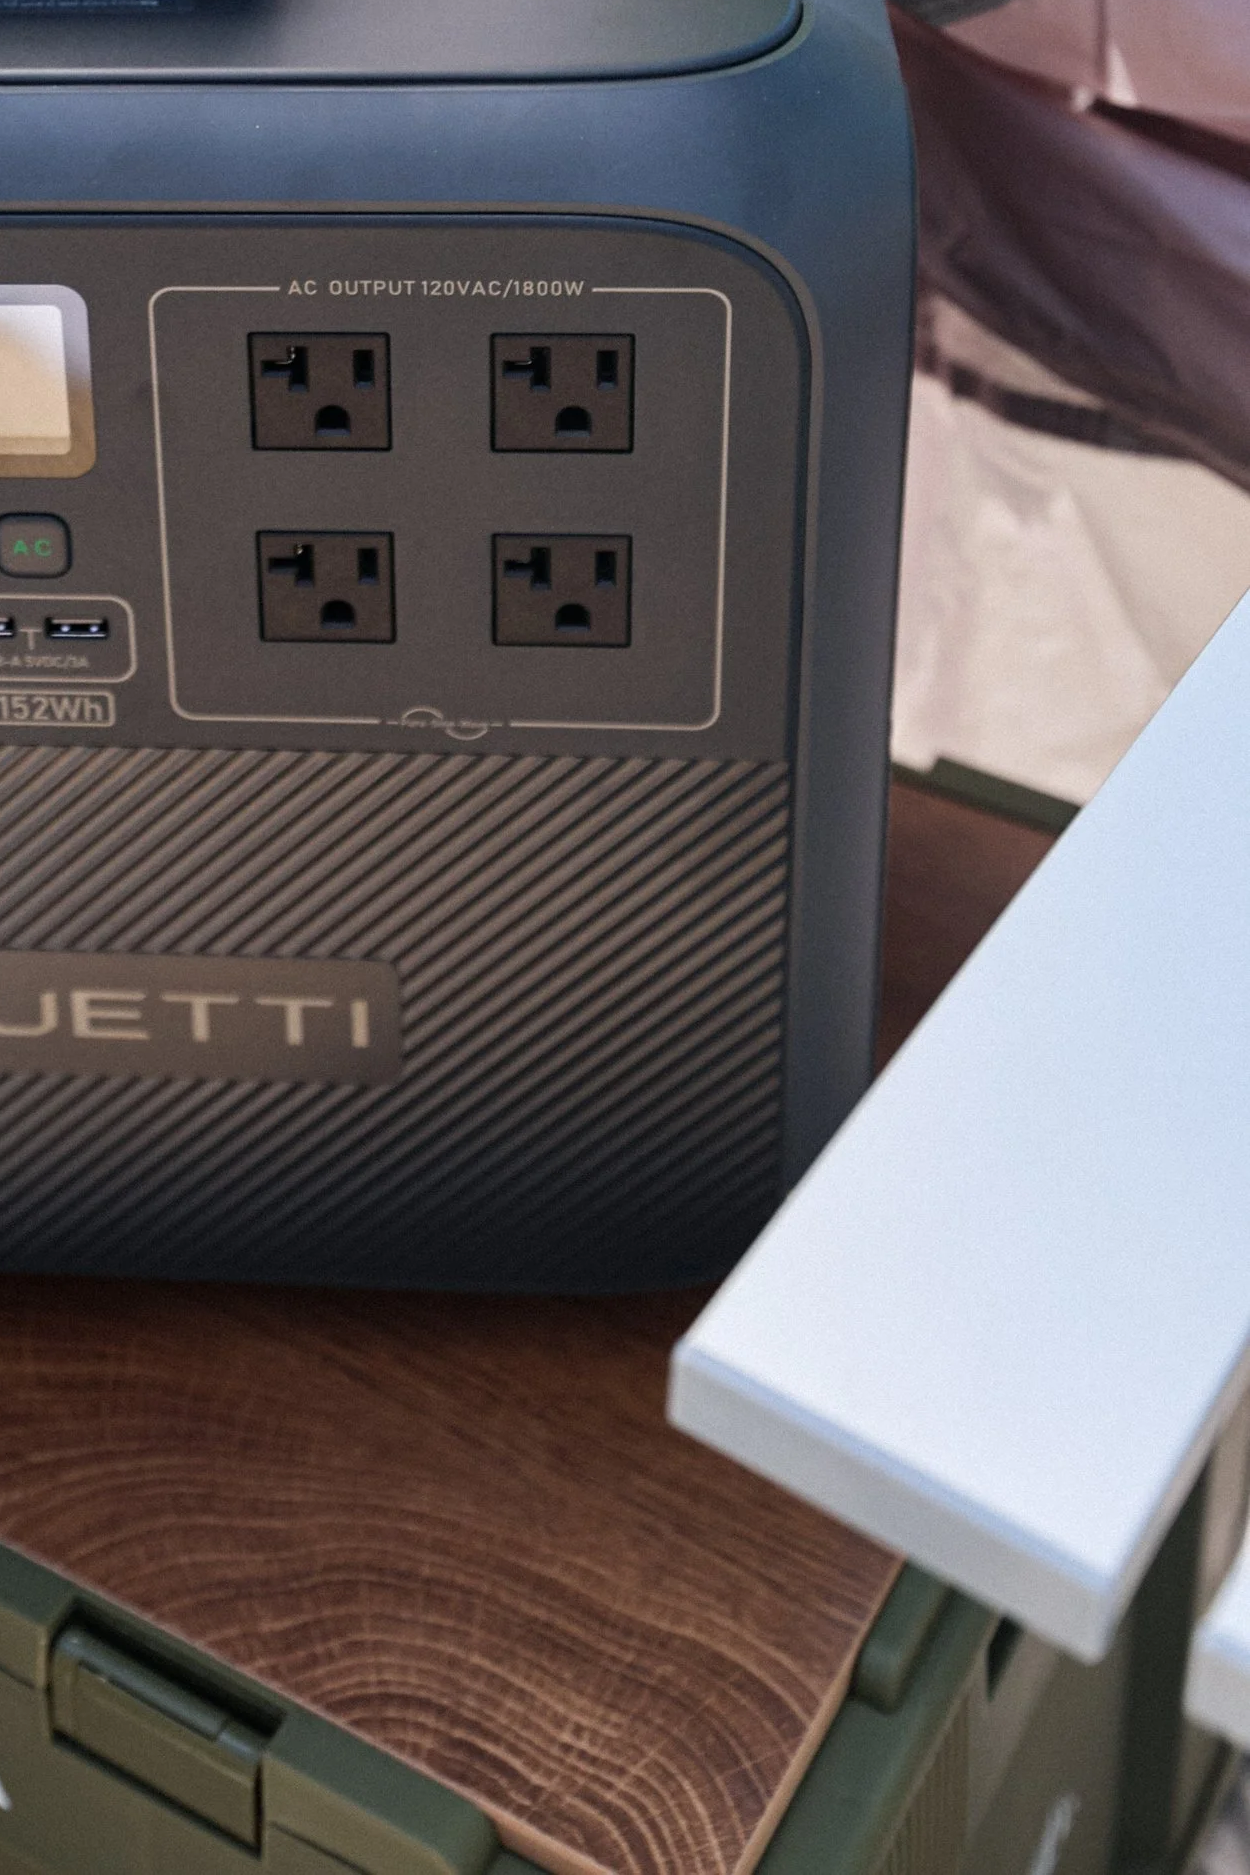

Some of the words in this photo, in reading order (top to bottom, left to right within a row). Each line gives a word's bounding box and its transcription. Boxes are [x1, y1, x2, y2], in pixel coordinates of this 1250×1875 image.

[288, 280, 317, 296] AC
[329, 280, 416, 297] OUTPUT
[422, 280, 585, 299] 120VAC/1800W
[12, 539, 52, 557] AC
